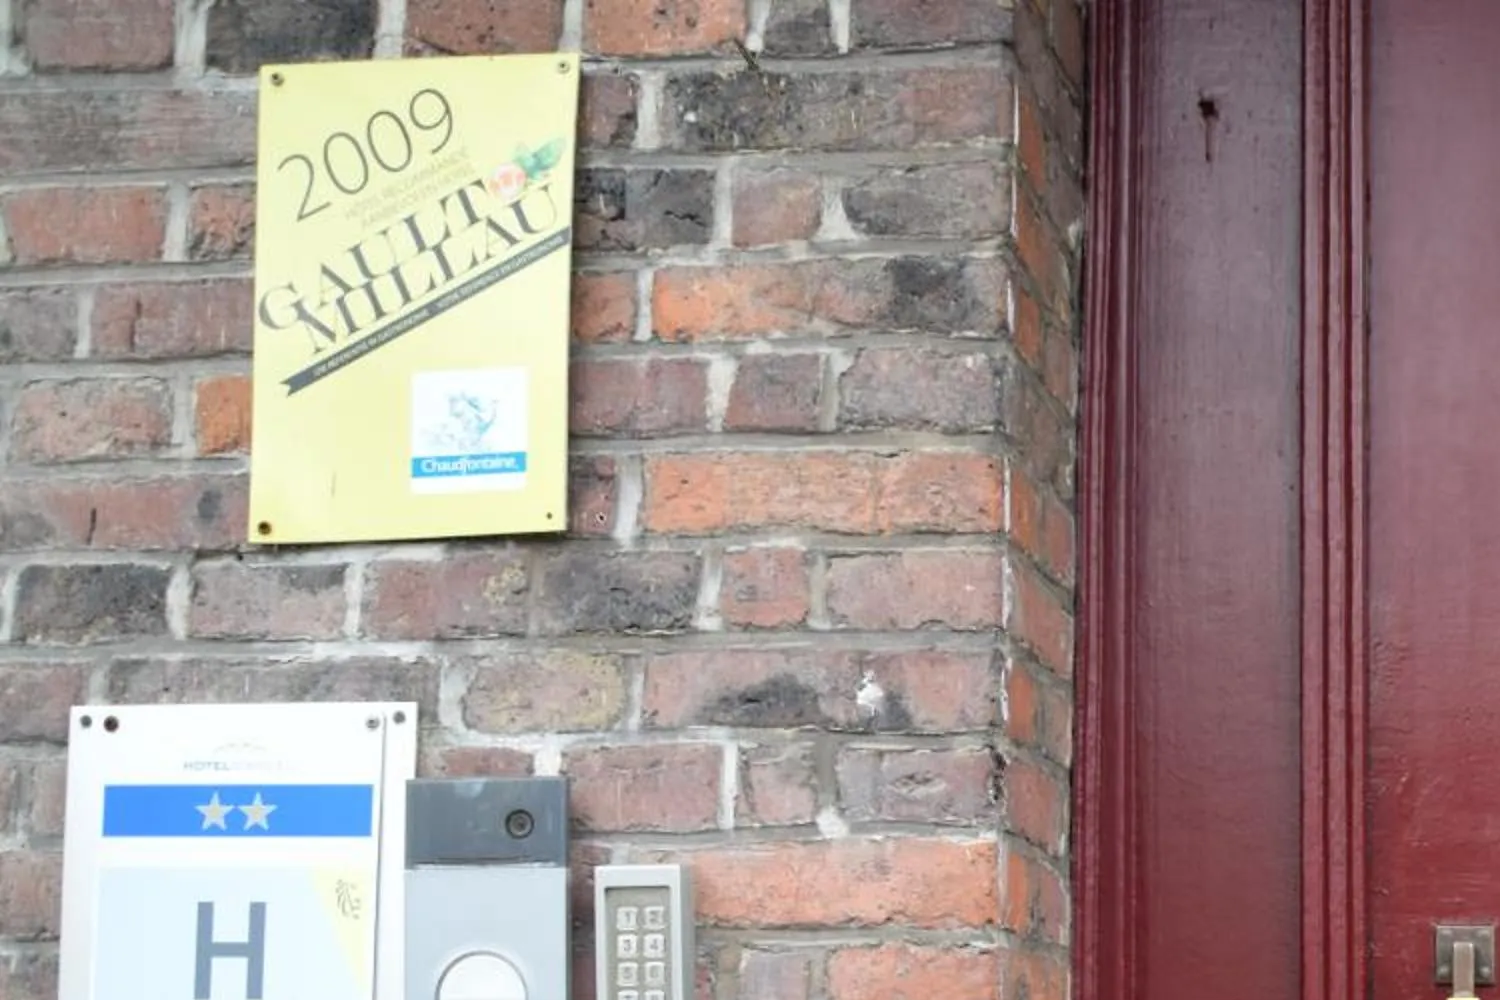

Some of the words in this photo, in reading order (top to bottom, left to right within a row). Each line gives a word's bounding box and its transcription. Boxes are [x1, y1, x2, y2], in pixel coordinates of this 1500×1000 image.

[277, 88, 453, 222] 2009
[258, 179, 486, 330] GAULT
[290, 183, 558, 354] MILLAU
[194, 901, 267, 1000] H
